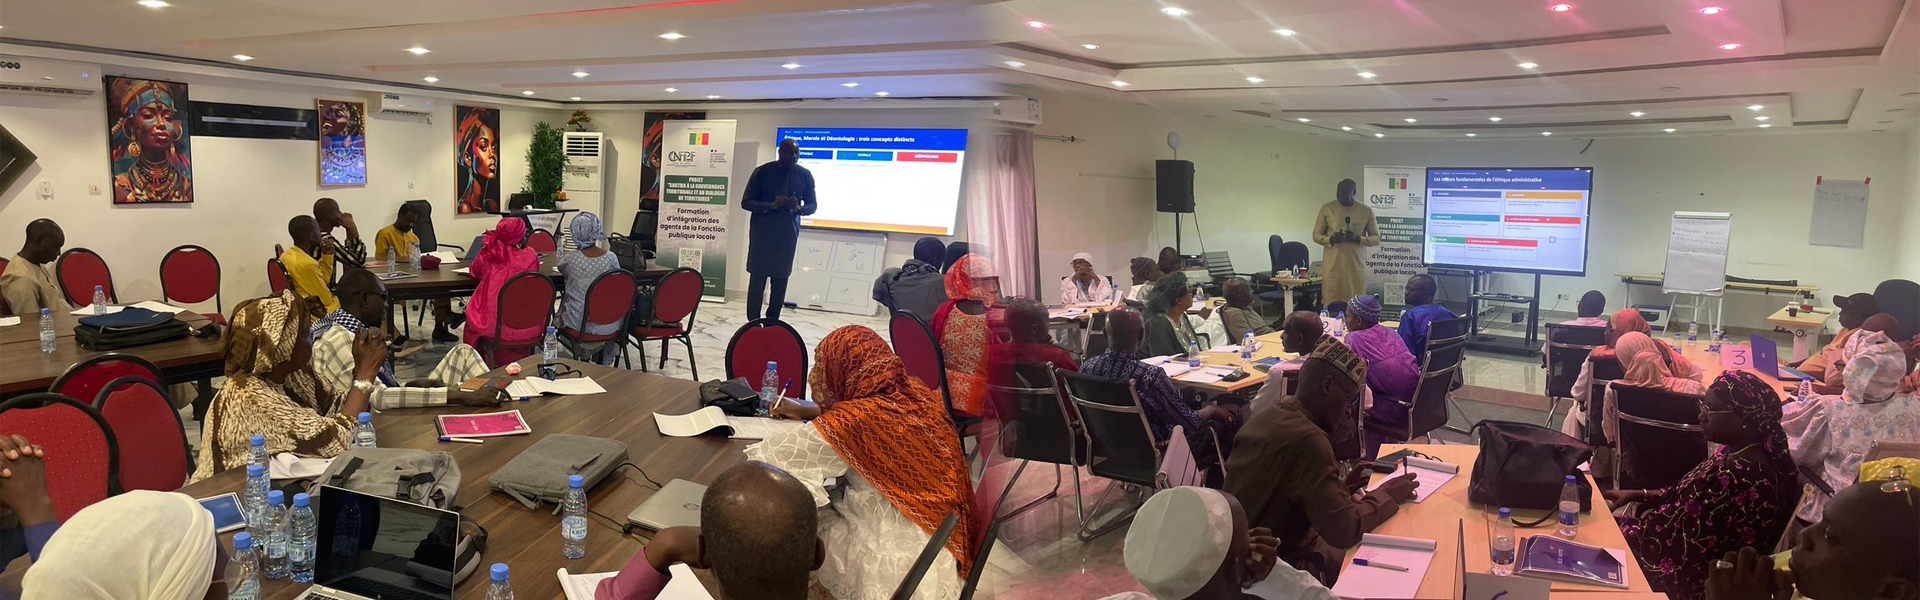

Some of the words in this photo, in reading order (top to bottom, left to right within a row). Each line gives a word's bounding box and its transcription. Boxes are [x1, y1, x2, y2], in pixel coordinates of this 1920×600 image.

[667, 215, 707, 224] d'intégration
[668, 232, 695, 240] publique
[1732, 350, 1746, 365] 3
